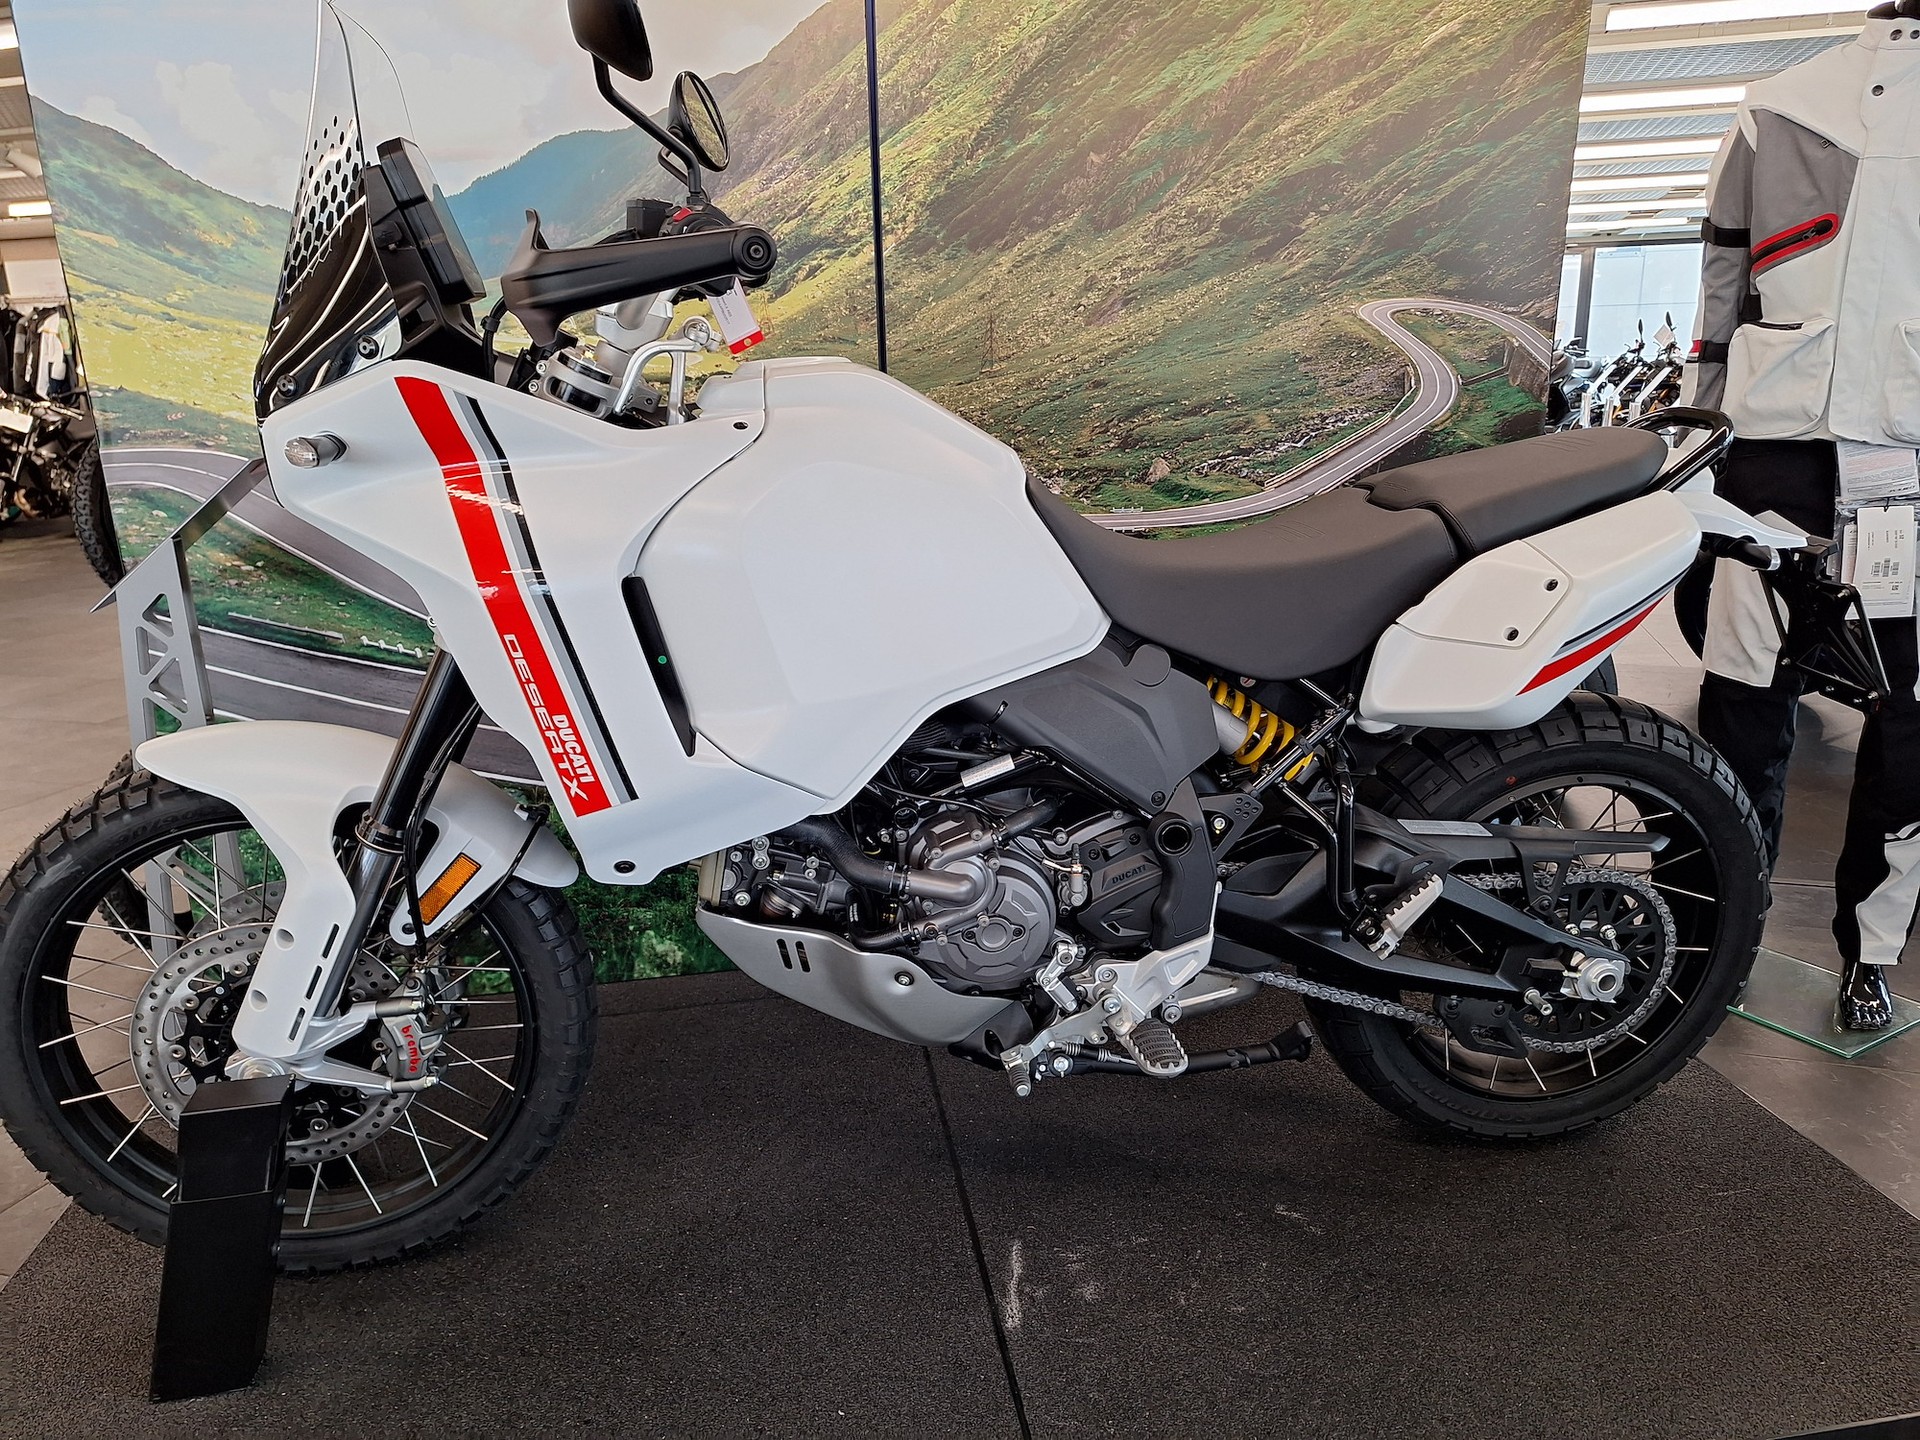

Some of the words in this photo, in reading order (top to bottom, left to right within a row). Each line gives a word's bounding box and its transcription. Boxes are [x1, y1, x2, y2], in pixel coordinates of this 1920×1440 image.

[503, 633, 589, 801] DESERTX
[552, 714, 595, 783] DUCATI
[1111, 864, 1147, 884] DUCATI
[401, 1024, 421, 1073] brembo
